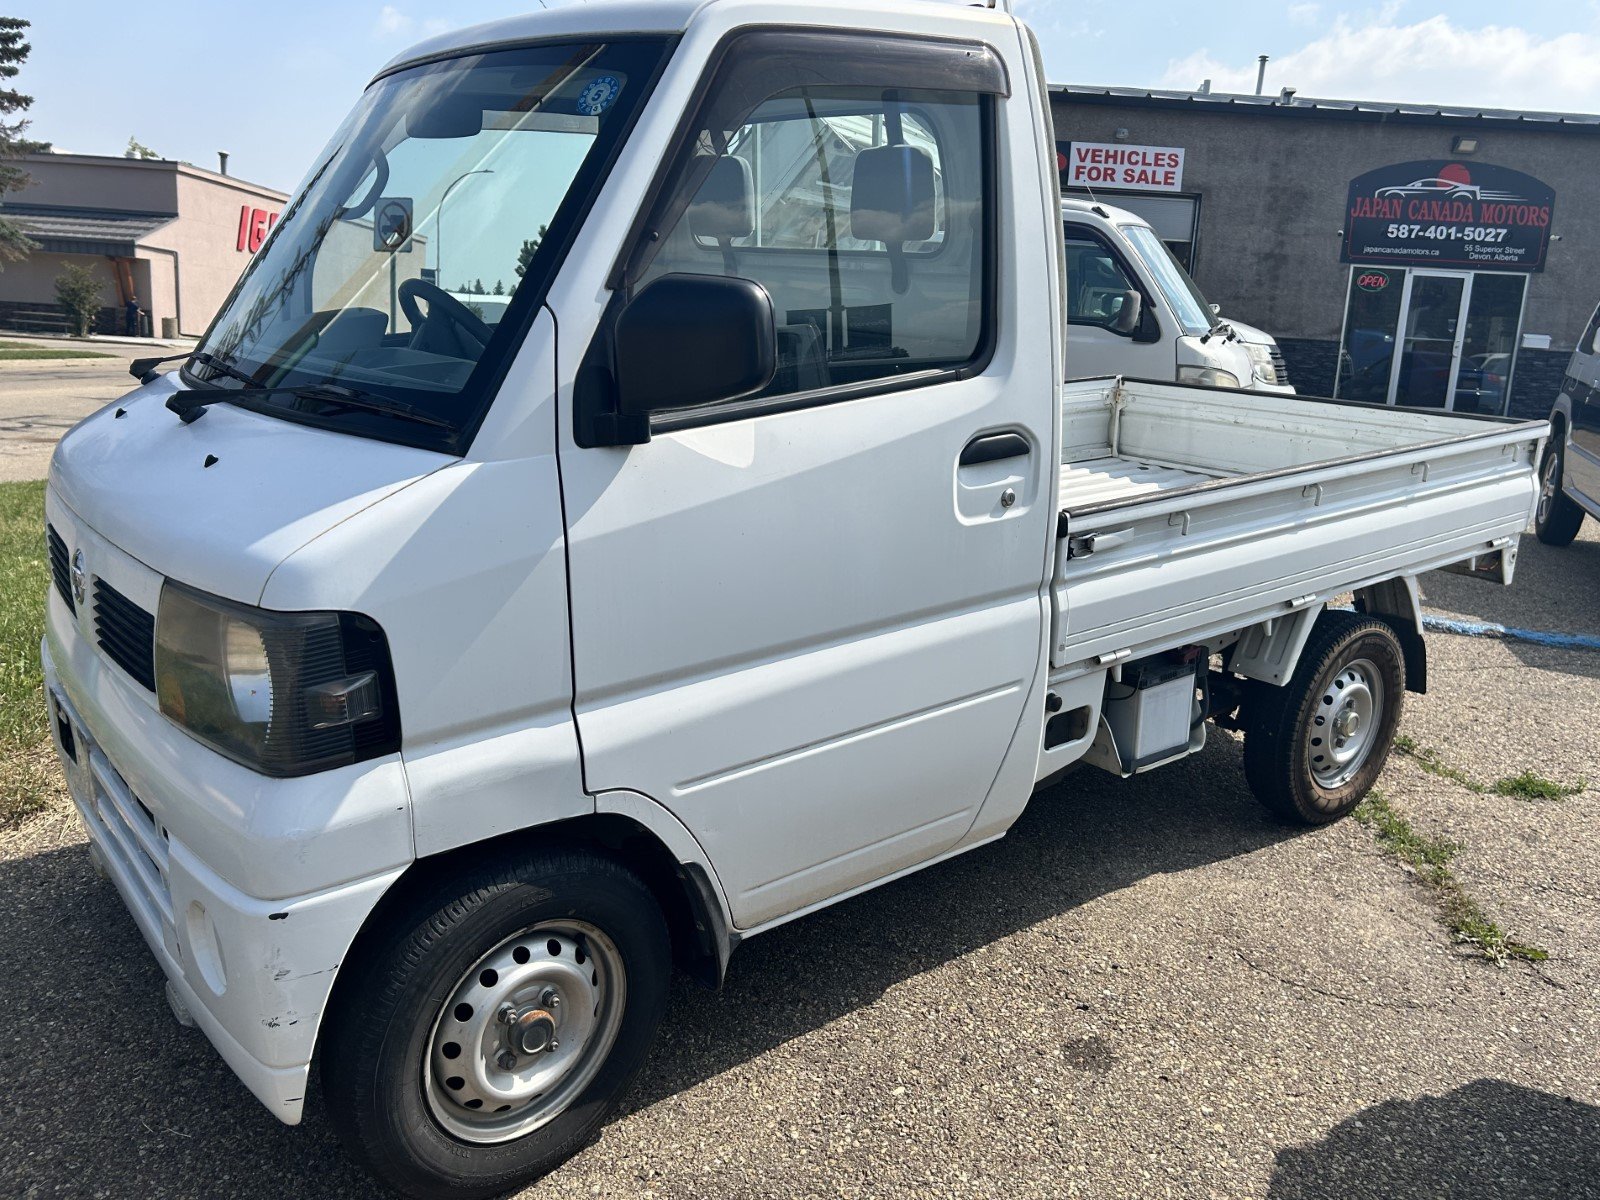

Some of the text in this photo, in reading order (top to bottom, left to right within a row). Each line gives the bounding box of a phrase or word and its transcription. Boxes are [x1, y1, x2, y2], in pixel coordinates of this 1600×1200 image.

[591, 90, 605, 102] 5
[1076, 148, 1179, 168] VEHICLES
[1074, 165, 1176, 186] FOR SALE
[1351, 197, 1549, 228] JAPAN CANADA MOTORS
[1387, 223, 1508, 242] 587-401-5027
[1363, 245, 1440, 256] japancanadamotors.ca
[1463, 244, 1526, 255] 55 Superior Street
[1493, 253, 1518, 261] Alberta
[1358, 275, 1387, 287] OPEN
